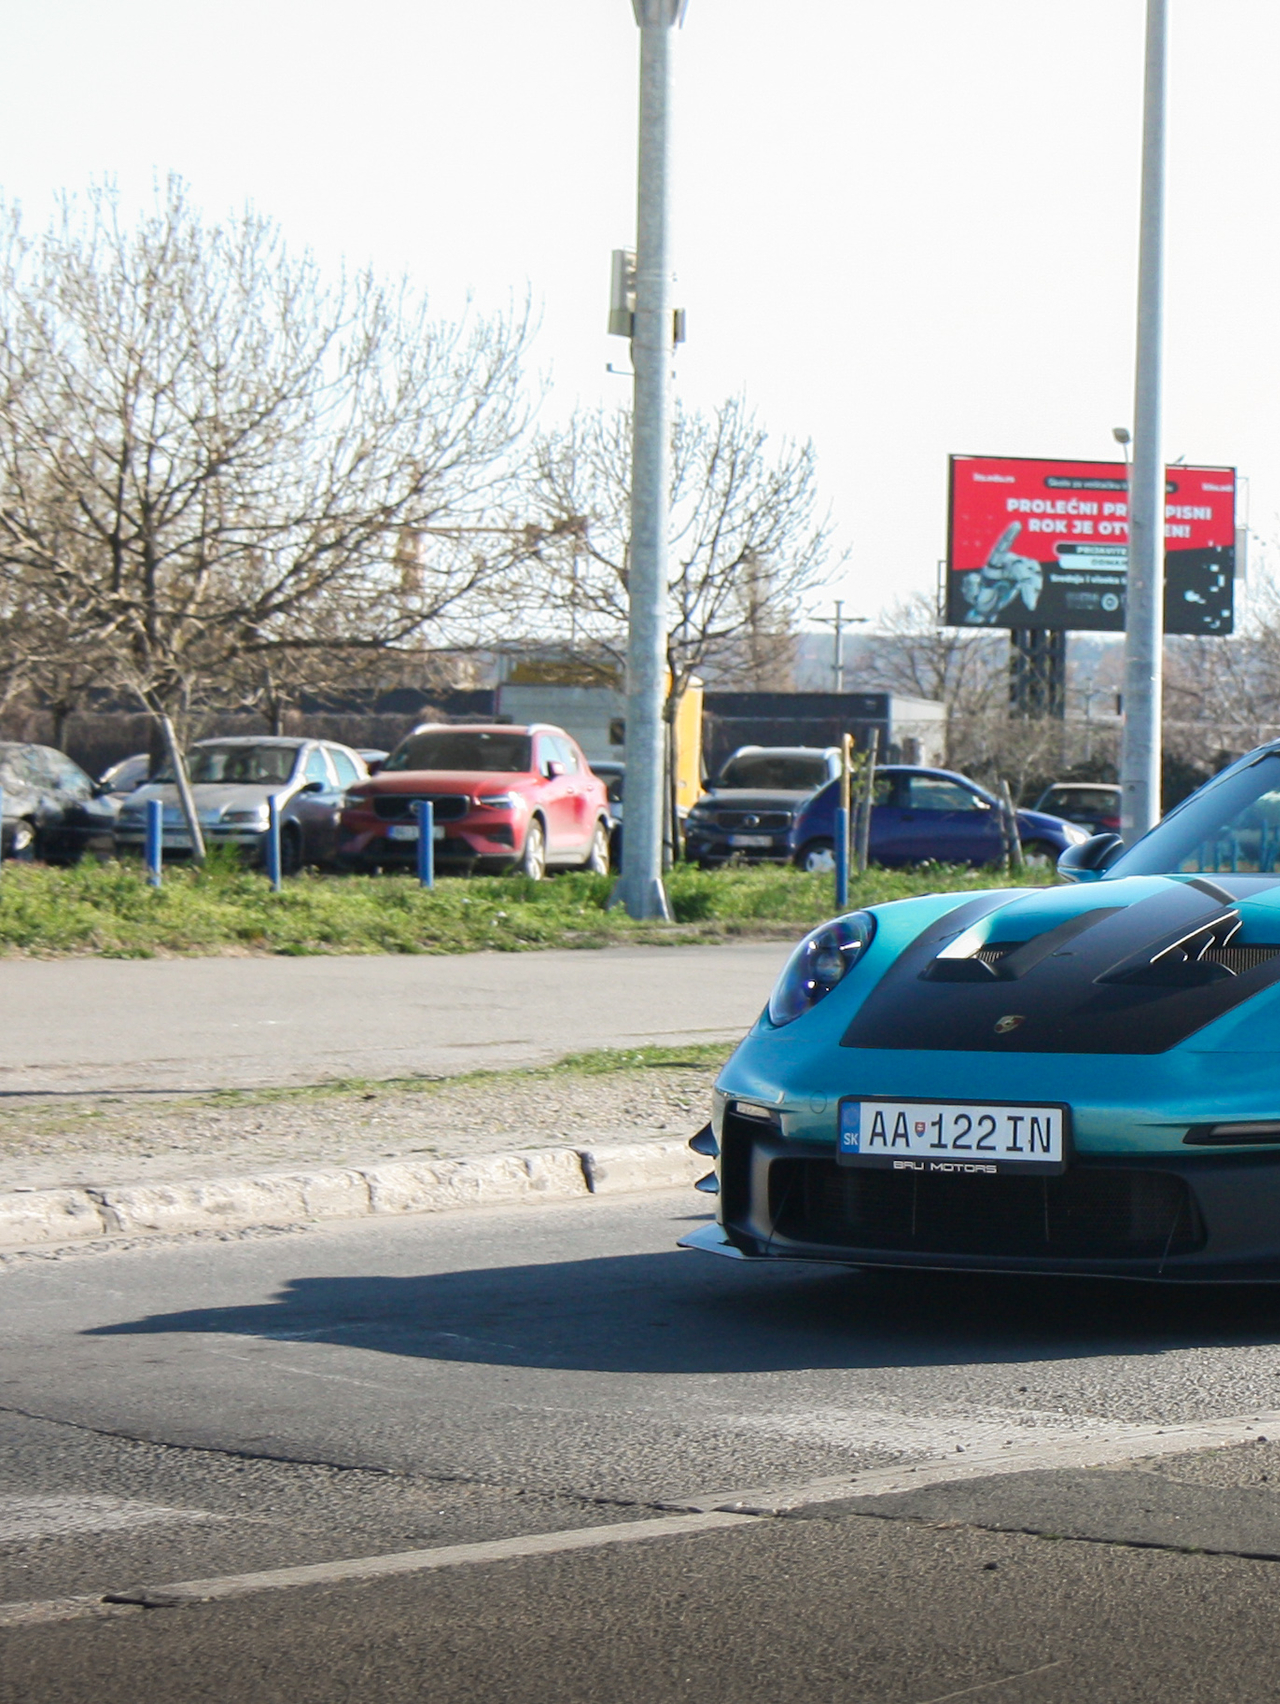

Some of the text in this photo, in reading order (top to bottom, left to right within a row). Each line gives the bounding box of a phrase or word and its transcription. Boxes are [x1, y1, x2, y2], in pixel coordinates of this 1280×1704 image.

[1006, 497, 1099, 516] PROLEĆNI
[1028, 518, 1068, 533] ROK
[1071, 519, 1094, 534] JE
[869, 1111, 910, 1148] AA
[843, 1132, 858, 1146] SK
[930, 1162, 997, 1173] MOTORS
